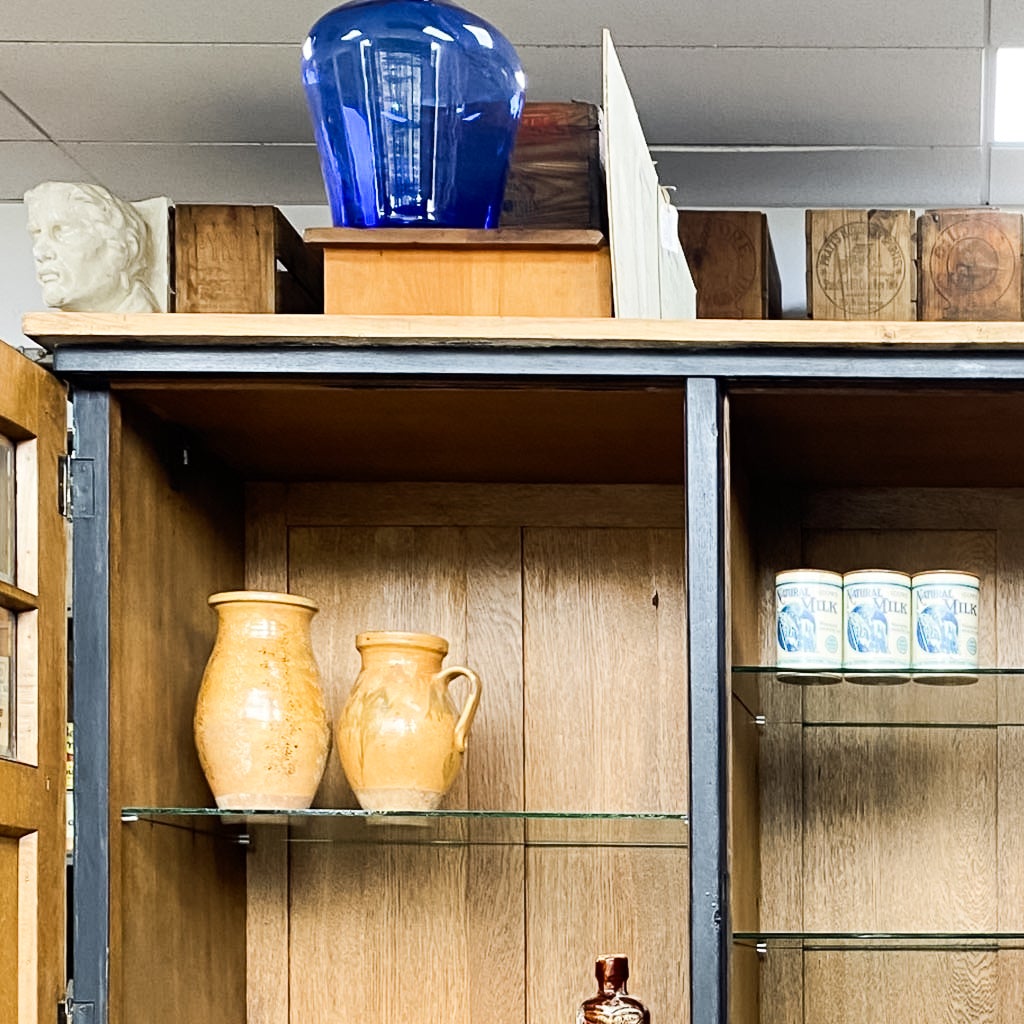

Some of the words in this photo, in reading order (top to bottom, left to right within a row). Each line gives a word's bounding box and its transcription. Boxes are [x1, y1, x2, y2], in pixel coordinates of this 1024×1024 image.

[801, 597, 838, 614] MILK
[872, 598, 908, 615] MILK
[942, 599, 977, 617] MILK
